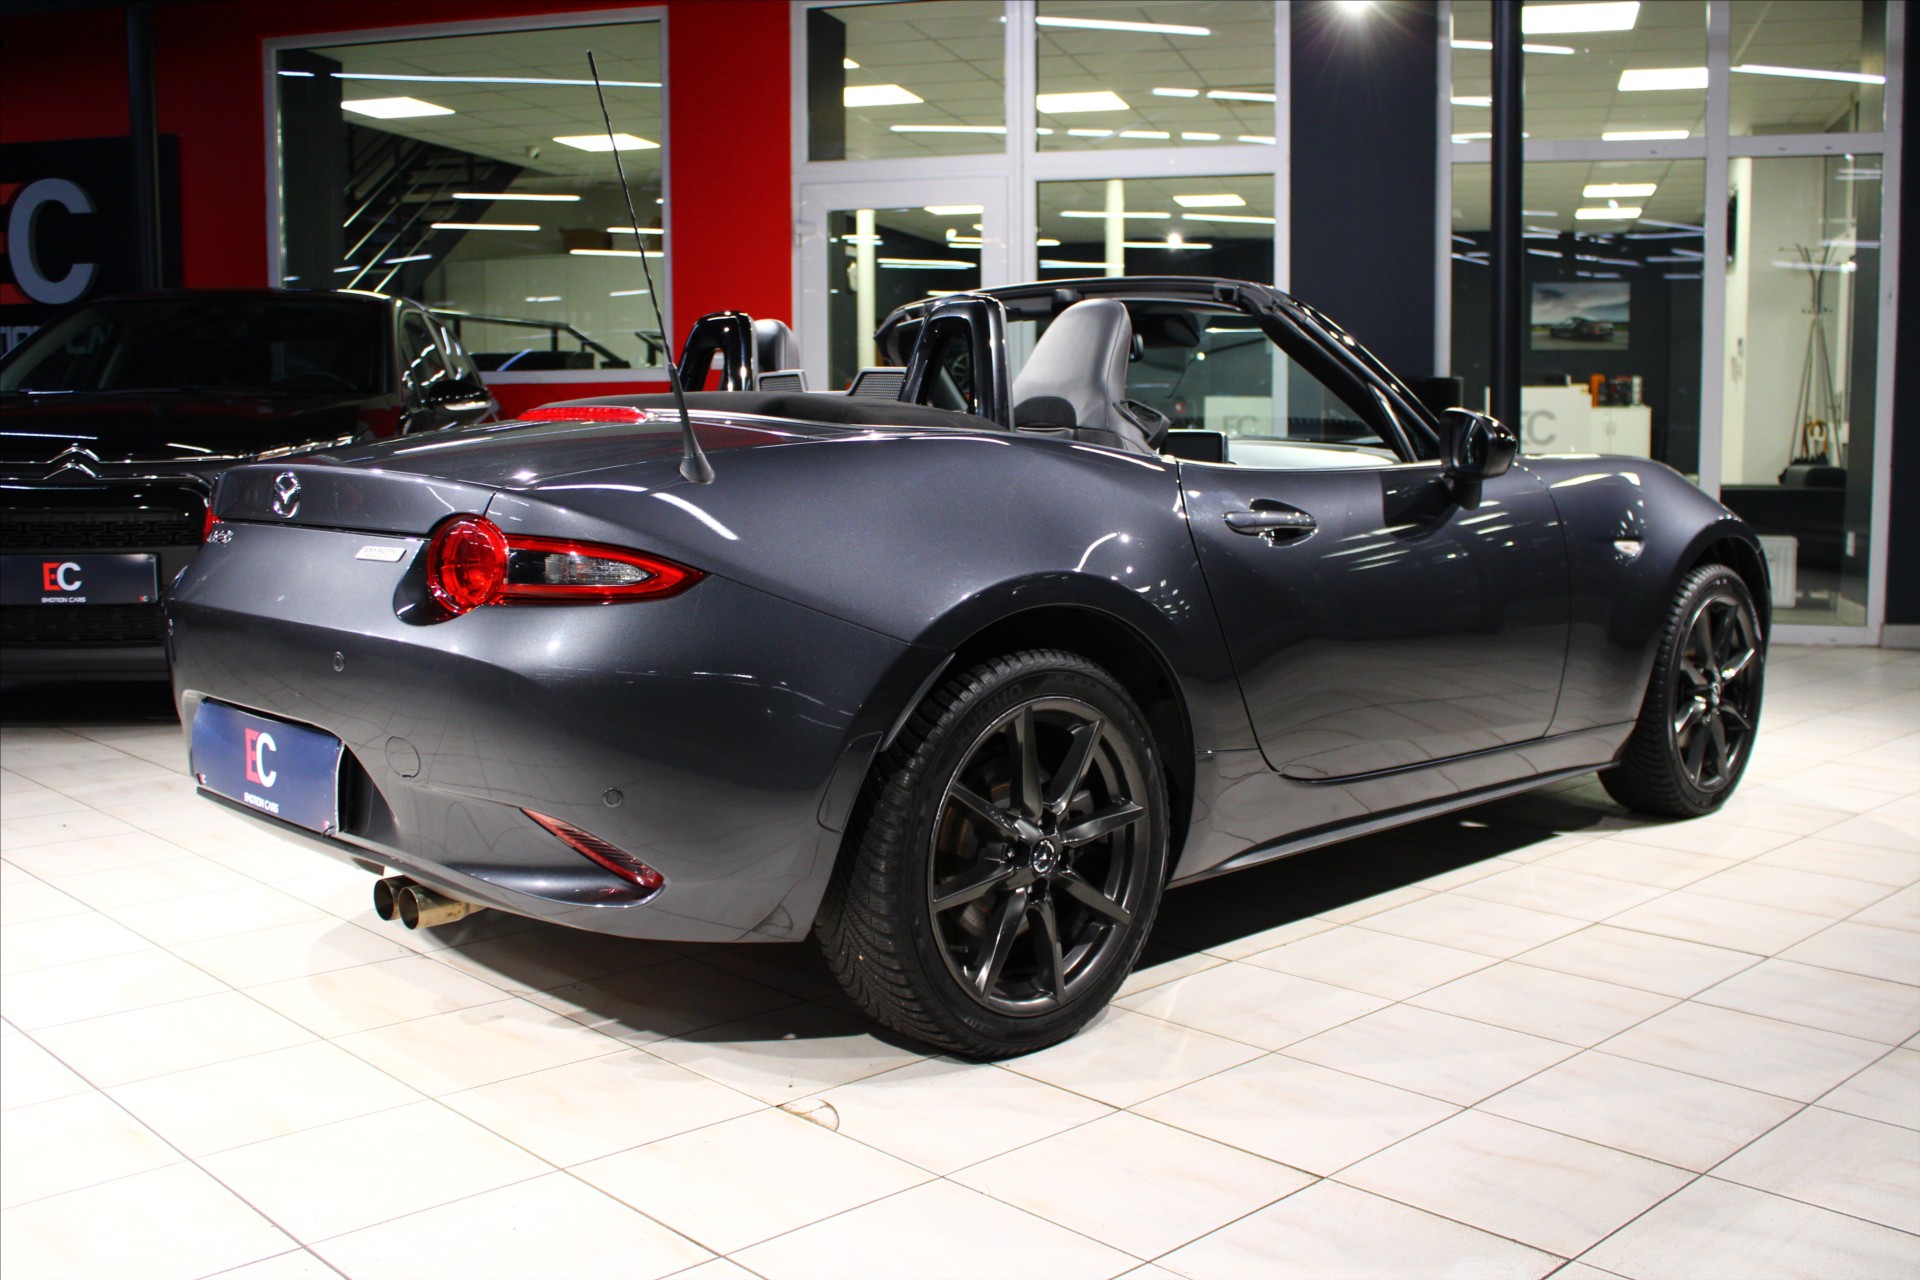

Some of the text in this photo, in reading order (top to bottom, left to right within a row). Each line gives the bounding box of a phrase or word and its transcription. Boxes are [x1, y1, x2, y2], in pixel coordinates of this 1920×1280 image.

[1521, 410, 1556, 446] C
[43, 562, 82, 591] EC
[245, 727, 277, 788] EC
